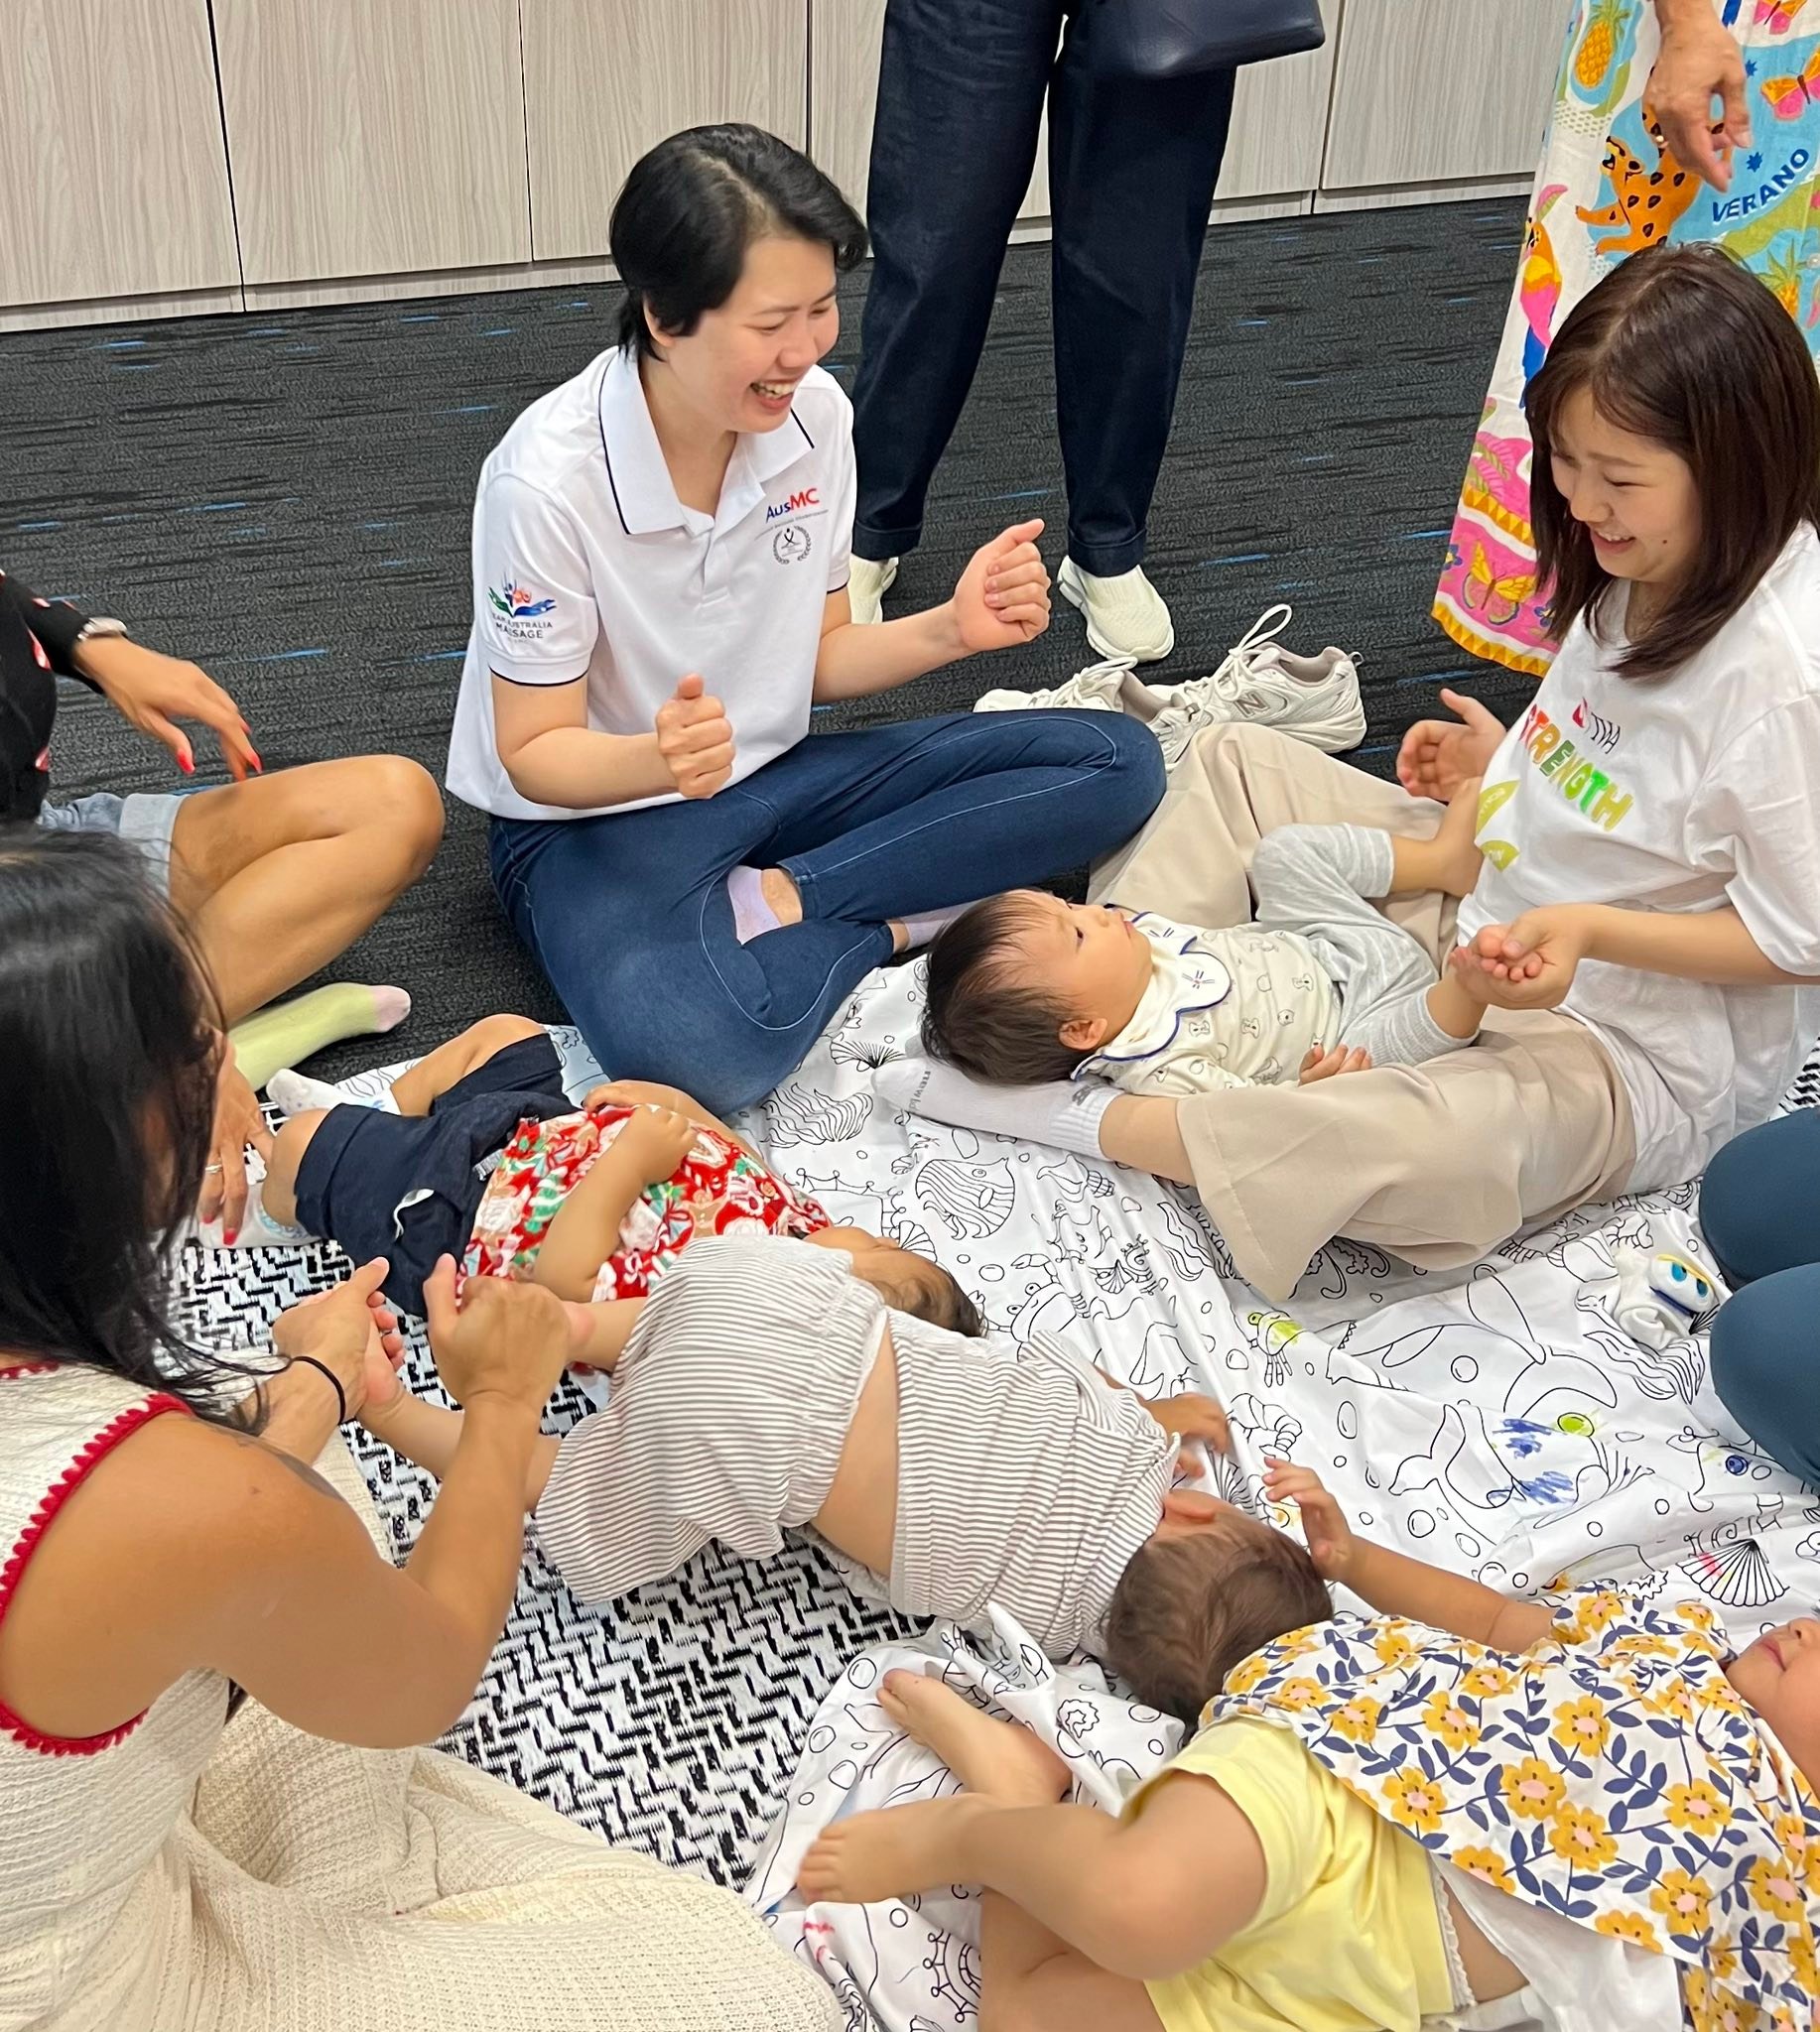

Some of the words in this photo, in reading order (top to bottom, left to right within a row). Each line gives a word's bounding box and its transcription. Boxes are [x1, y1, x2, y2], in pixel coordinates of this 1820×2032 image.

[1712, 148, 1810, 222] VERANO
[765, 487, 820, 523] AusMC
[1234, 692, 1270, 718] N
